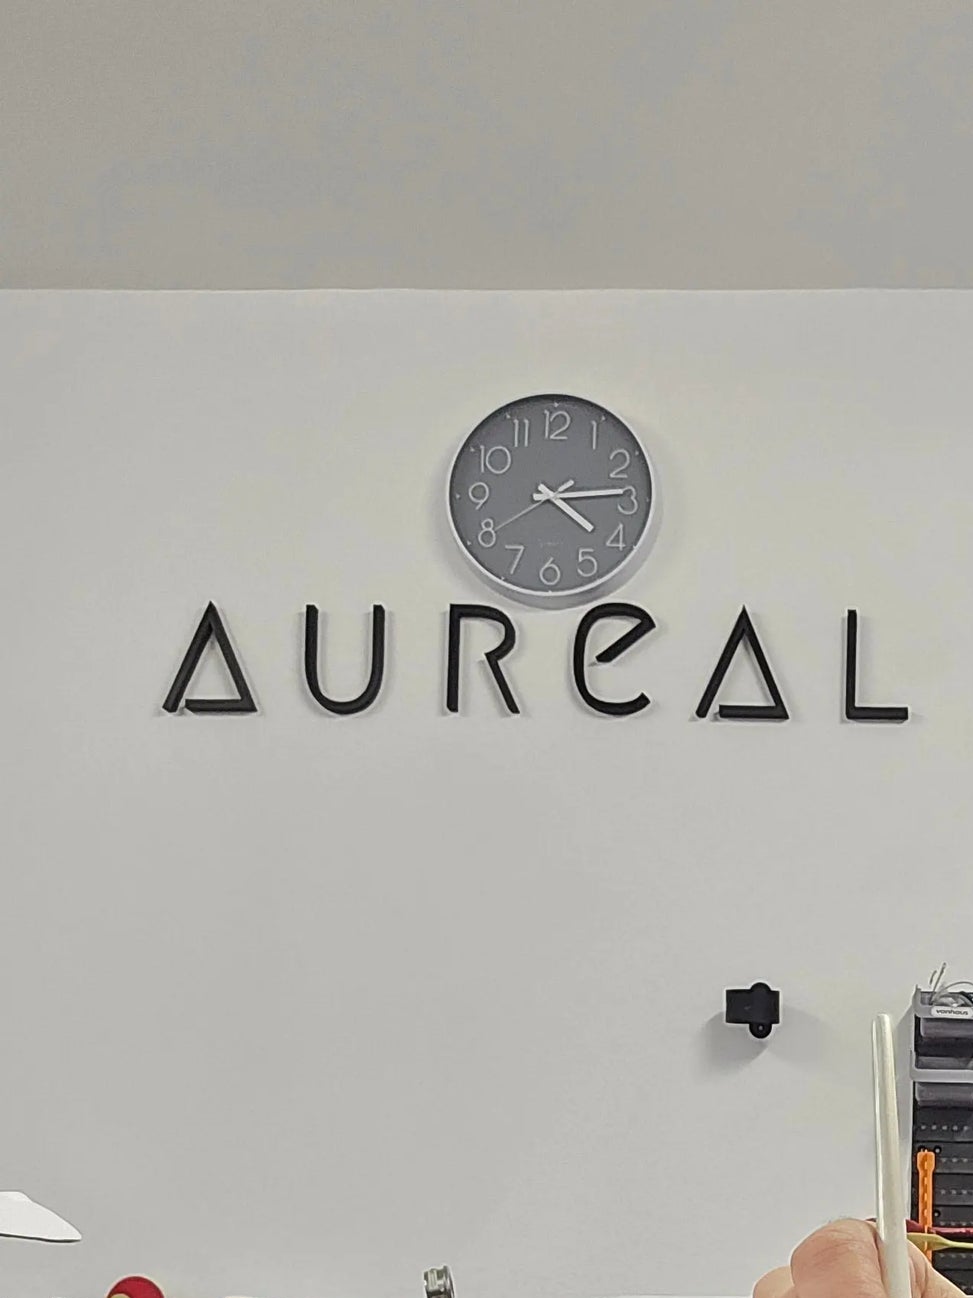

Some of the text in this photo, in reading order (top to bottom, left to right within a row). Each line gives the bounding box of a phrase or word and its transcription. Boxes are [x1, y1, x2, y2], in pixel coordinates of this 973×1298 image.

[514, 419, 529, 447] 11
[544, 410, 571, 440] 12
[591, 420, 596, 450] 1
[480, 445, 511, 474] 10
[609, 449, 630, 478] 2
[469, 482, 489, 511] 9
[617, 485, 638, 515] 3
[478, 519, 496, 547] 8
[606, 522, 626, 551] 4
[505, 545, 524, 574] 7
[539, 557, 561, 586] 6
[577, 548, 598, 577] 5
